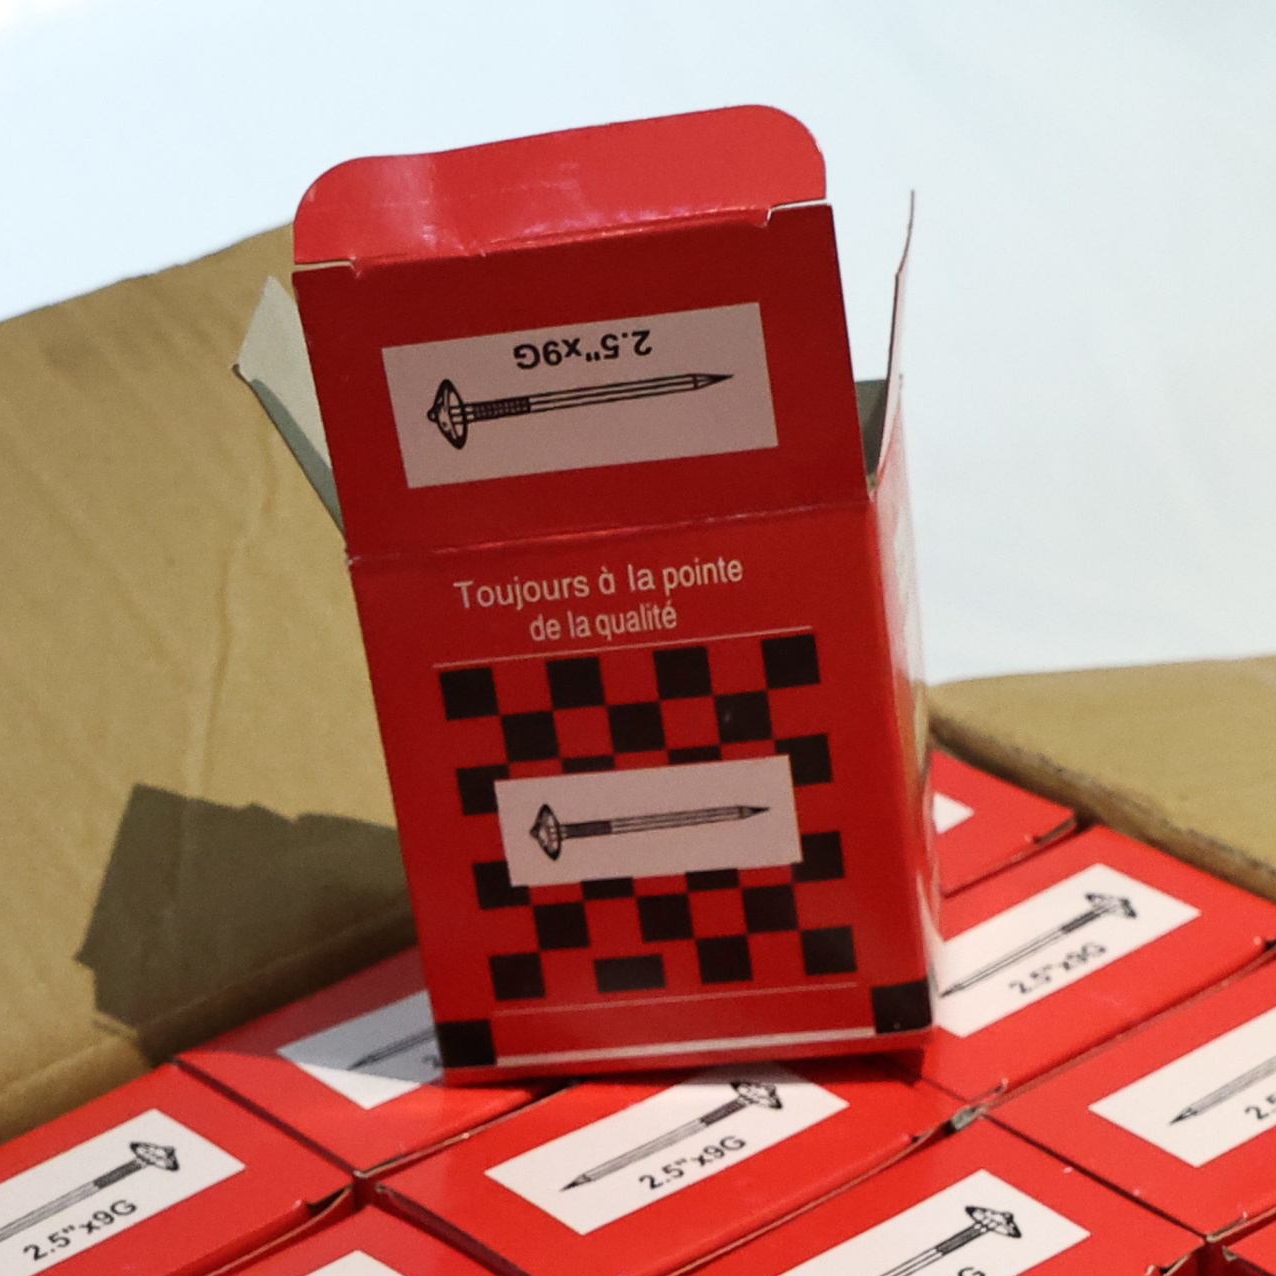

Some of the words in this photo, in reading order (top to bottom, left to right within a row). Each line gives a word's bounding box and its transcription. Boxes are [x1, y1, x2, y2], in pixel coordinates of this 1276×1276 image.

[453, 574, 590, 610] Toujours
[597, 565, 616, 595] à
[627, 563, 656, 592] la
[662, 556, 744, 596] pointe
[529, 613, 562, 642] de
[567, 610, 592, 638] la
[595, 599, 678, 641] qualité
[24, 1200, 136, 1260] 2.5"x9G
